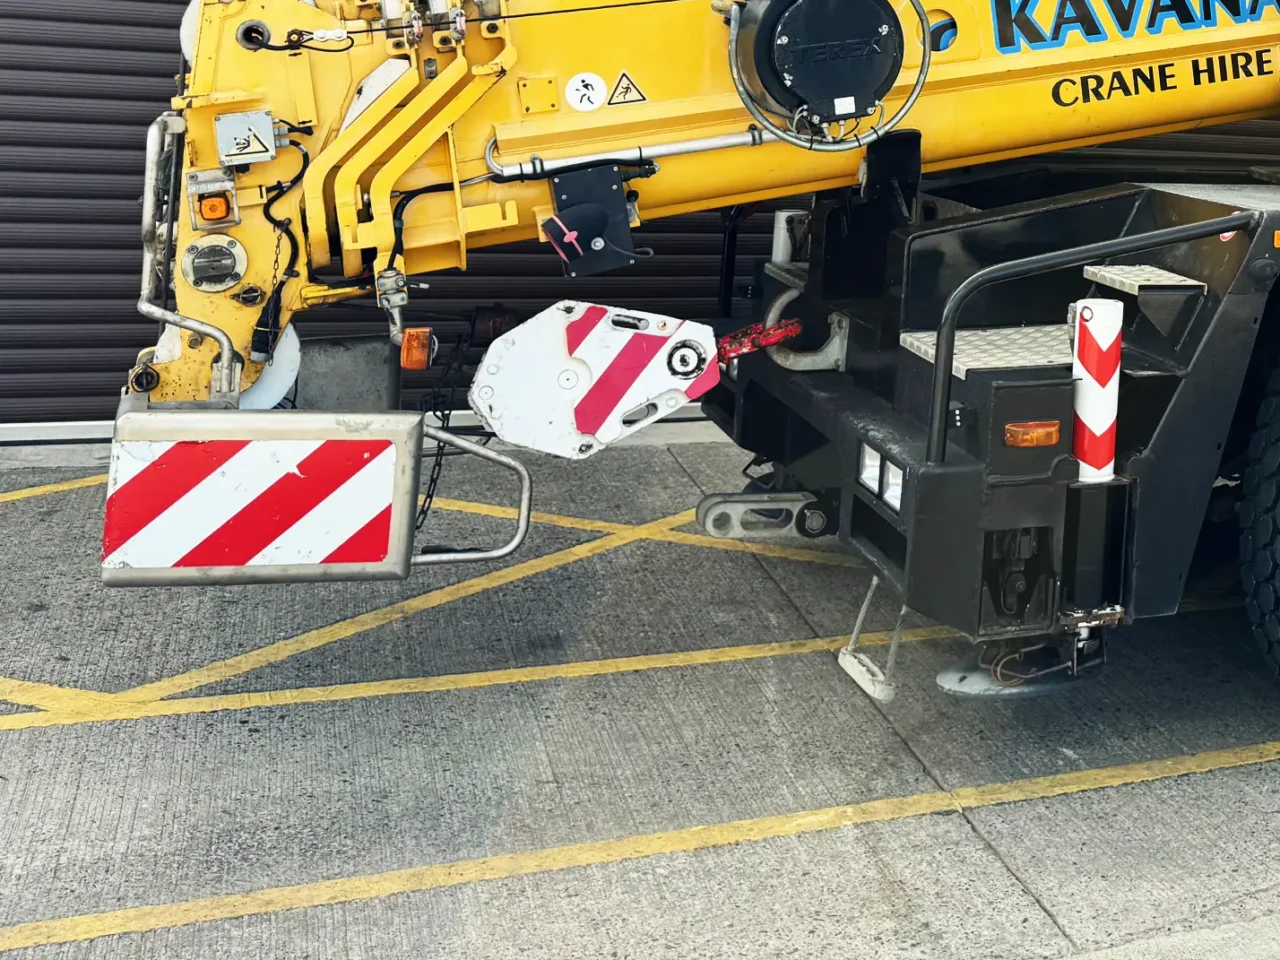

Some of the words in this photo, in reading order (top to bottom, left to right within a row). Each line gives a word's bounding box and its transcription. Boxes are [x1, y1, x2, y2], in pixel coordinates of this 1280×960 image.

[791, 38, 882, 66] TEREX
[1051, 62, 1177, 107] CRANE
[1193, 48, 1274, 86] HIRE
